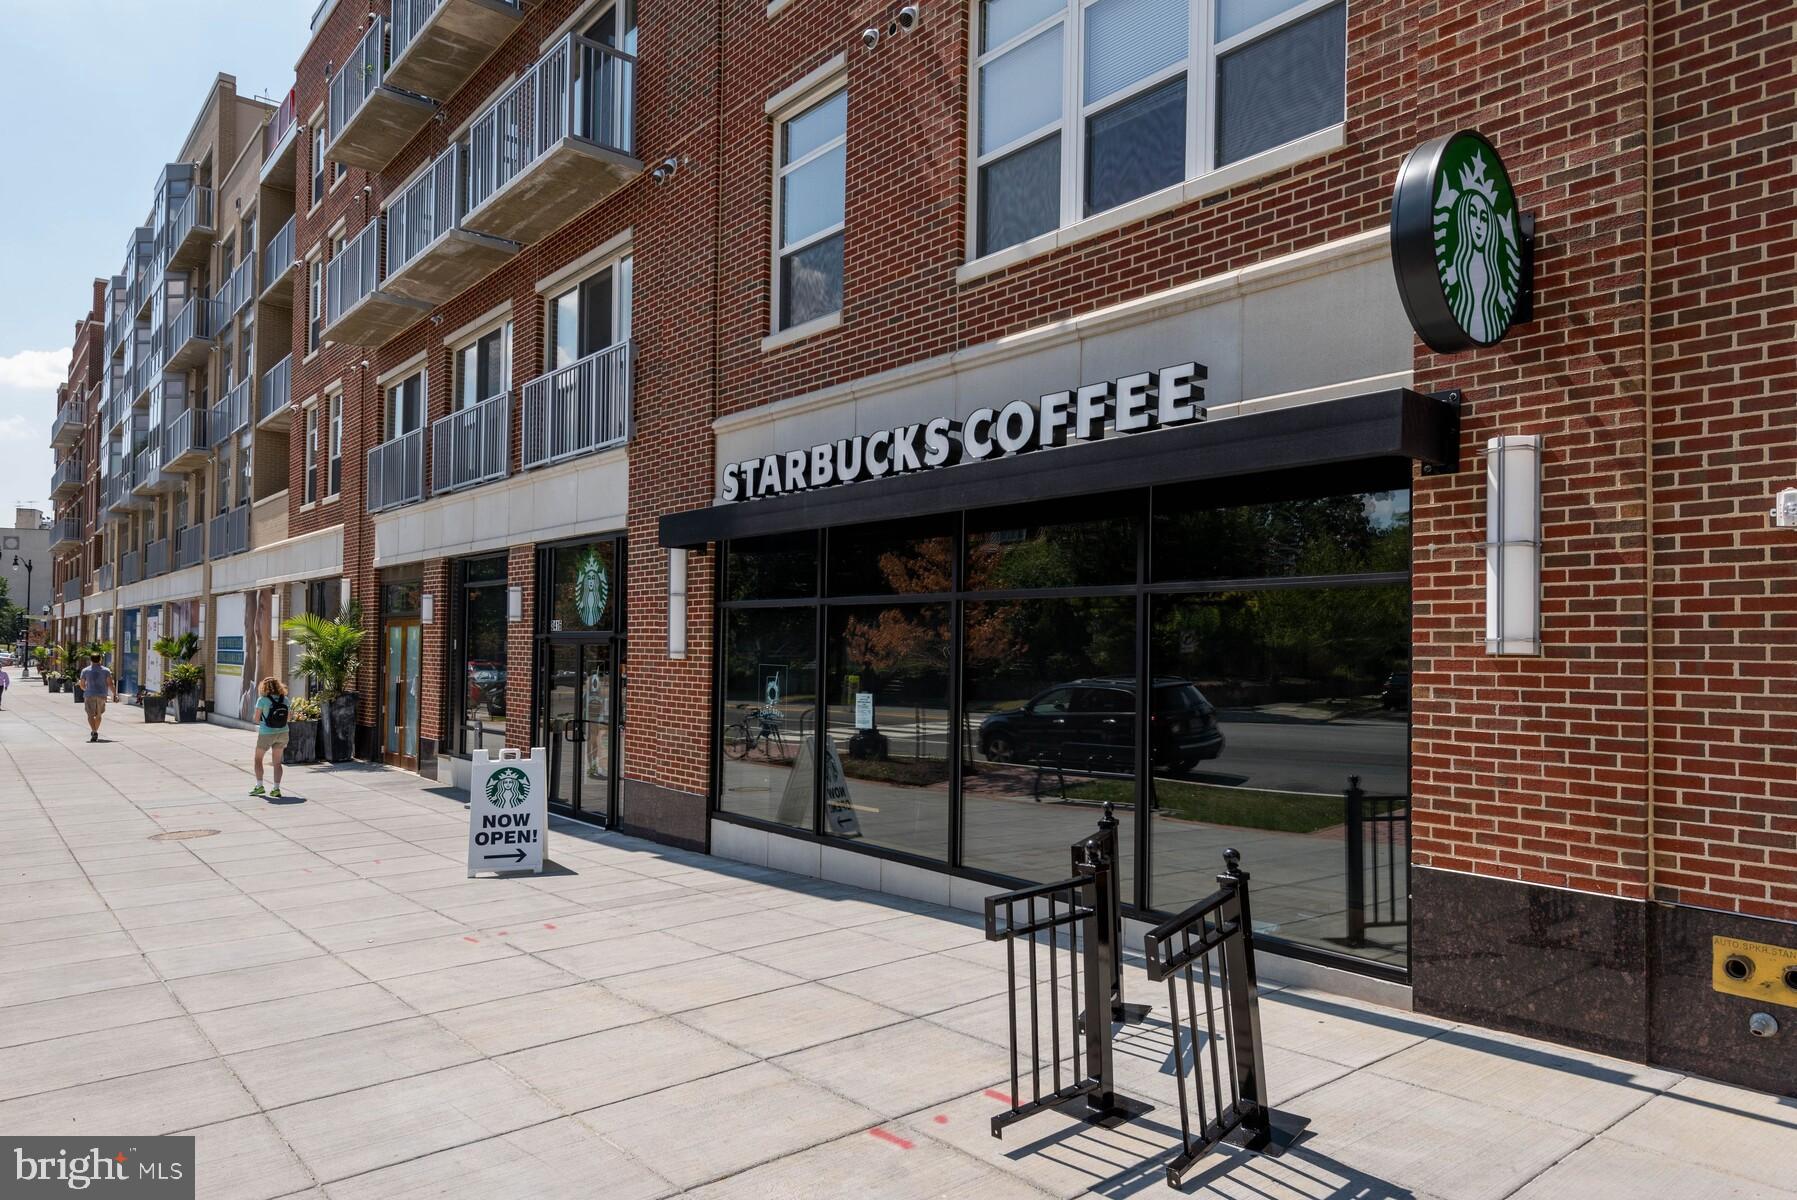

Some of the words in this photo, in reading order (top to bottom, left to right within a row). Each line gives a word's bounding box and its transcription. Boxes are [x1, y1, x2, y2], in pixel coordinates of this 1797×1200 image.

[721, 416, 951, 502] STARBUCKS
[962, 361, 1203, 459] COFFEE
[482, 813, 531, 829] NOW
[474, 829, 538, 846] OPEN!
